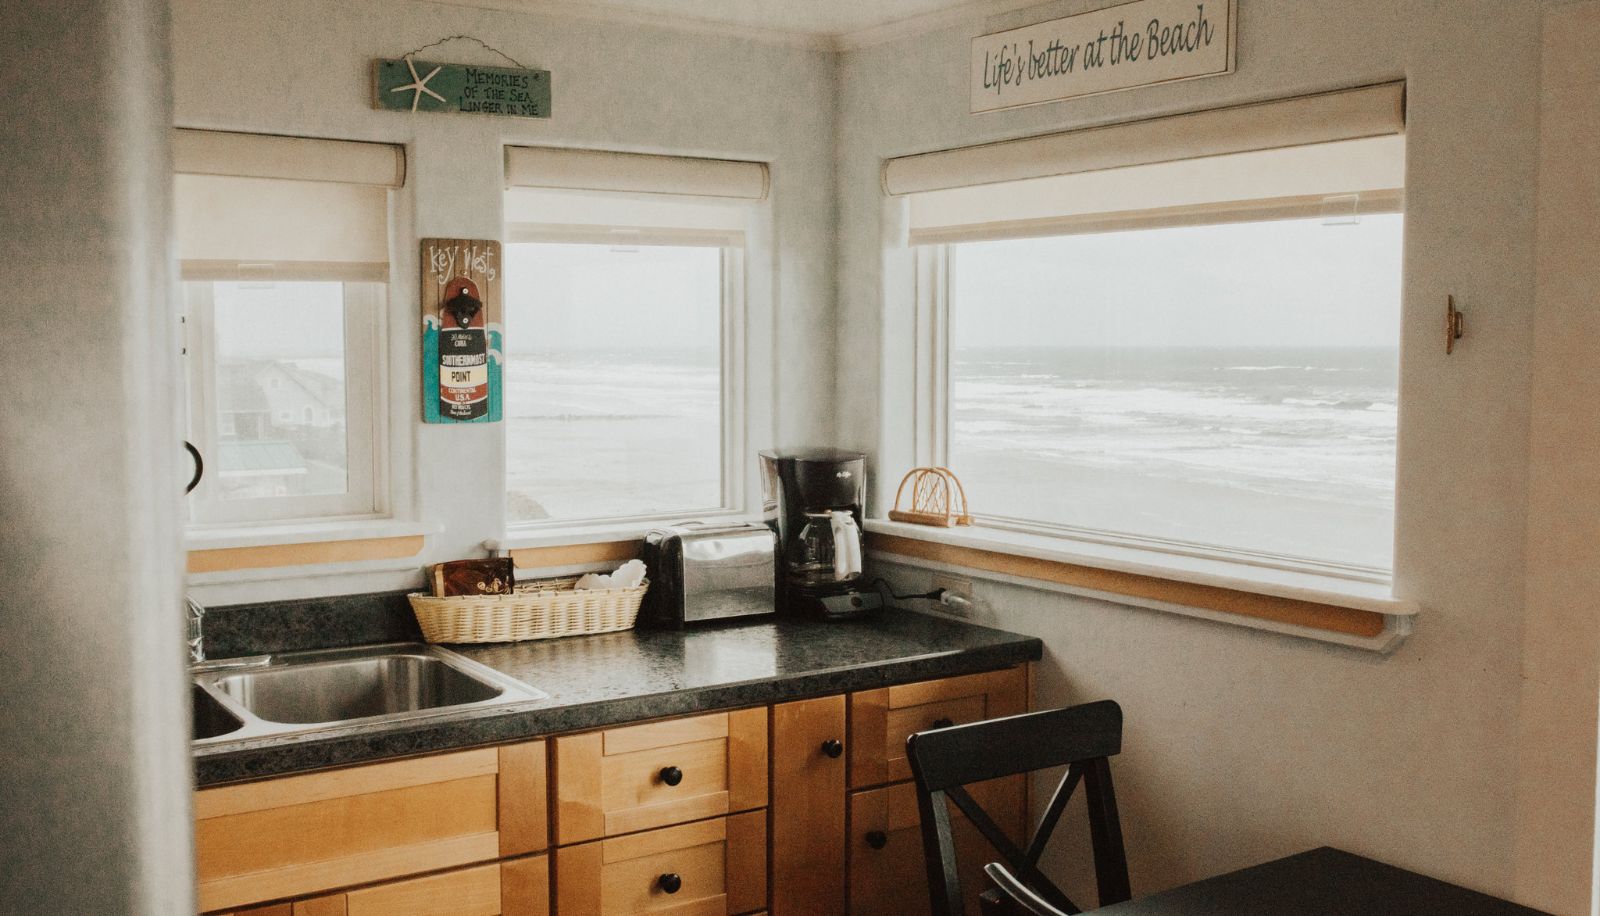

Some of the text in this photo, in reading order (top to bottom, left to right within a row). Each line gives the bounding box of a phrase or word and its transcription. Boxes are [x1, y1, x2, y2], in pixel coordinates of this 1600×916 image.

[983, 4, 1215, 94] Life's better at the Beach
[466, 68, 528, 89] MEMORIES
[464, 85, 533, 103] OF THE SEA
[459, 96, 539, 116] LINGER IN ME
[463, 246, 496, 281] West
[451, 371, 471, 382] POINT
